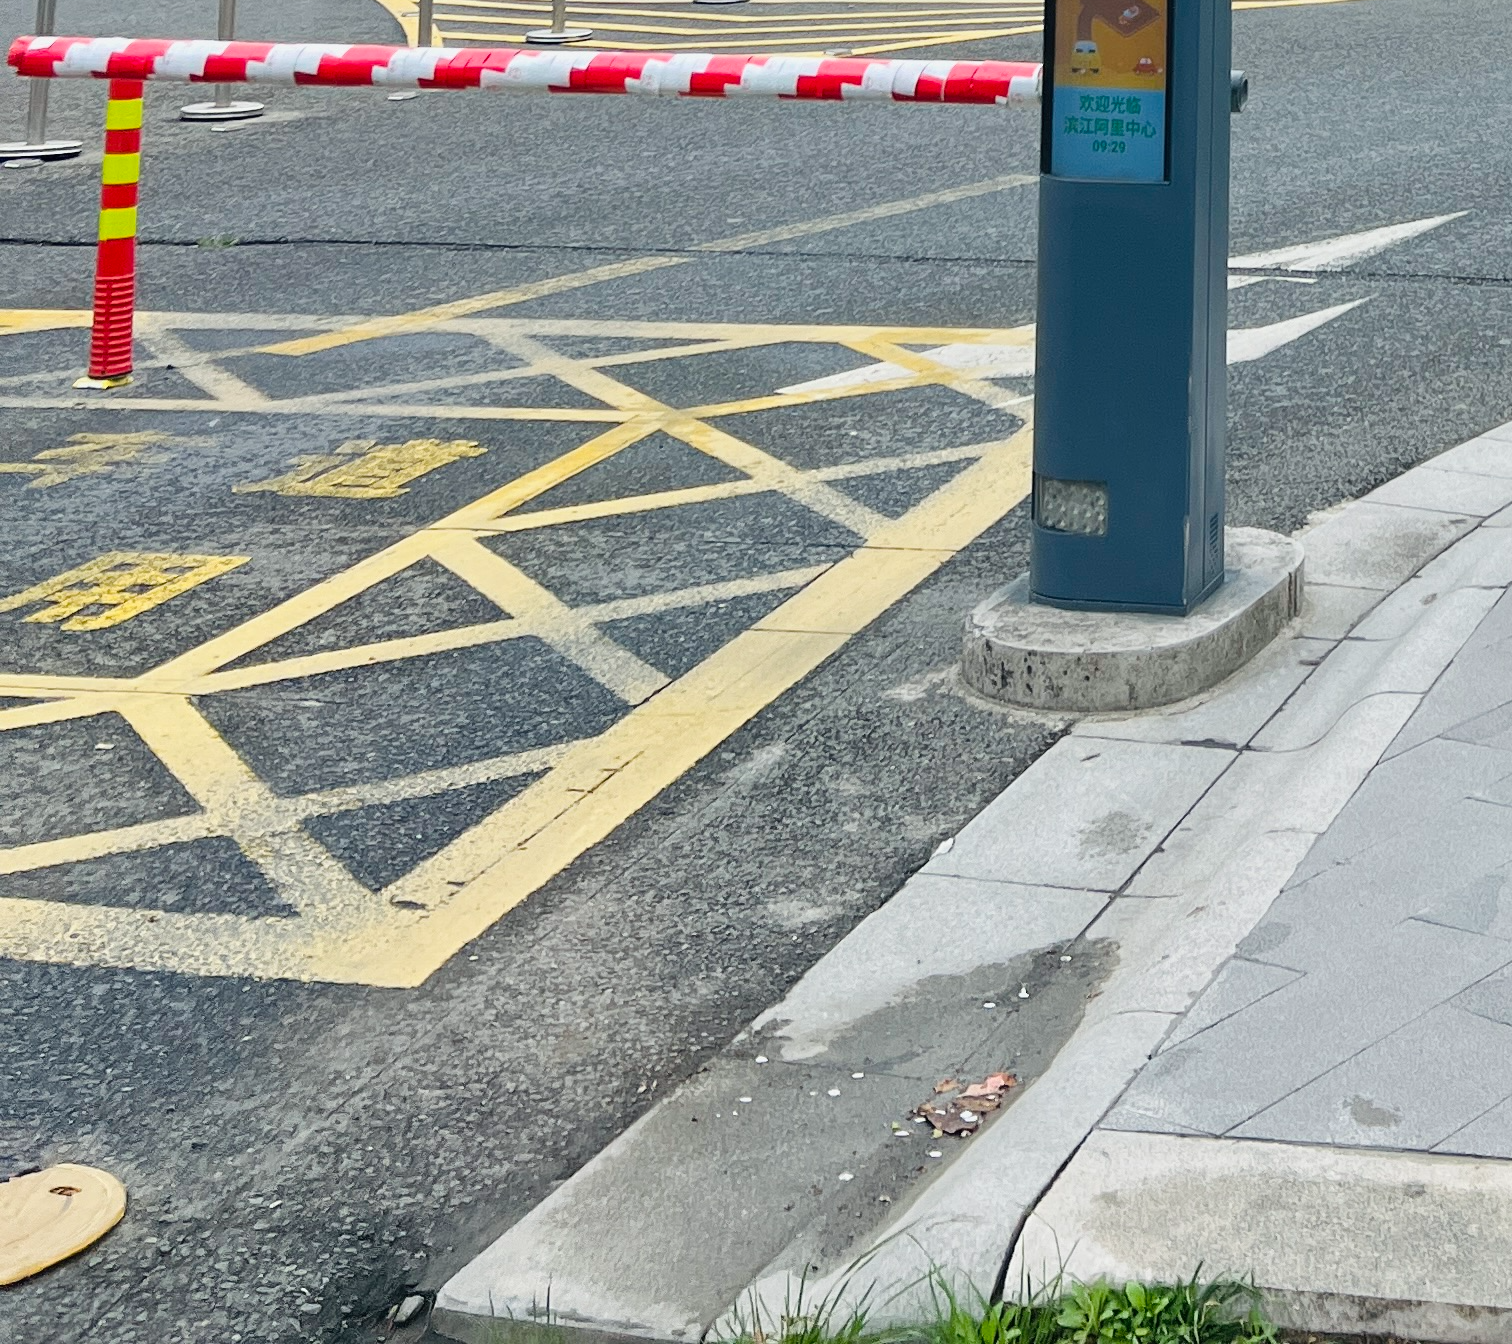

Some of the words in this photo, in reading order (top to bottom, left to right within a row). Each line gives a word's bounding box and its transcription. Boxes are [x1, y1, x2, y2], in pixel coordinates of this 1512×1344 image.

[1079, 94, 1141, 115] 欢迎光临
[1063, 115, 1157, 138] 滨江阿里中心
[1092, 139, 1126, 153] 09:29
